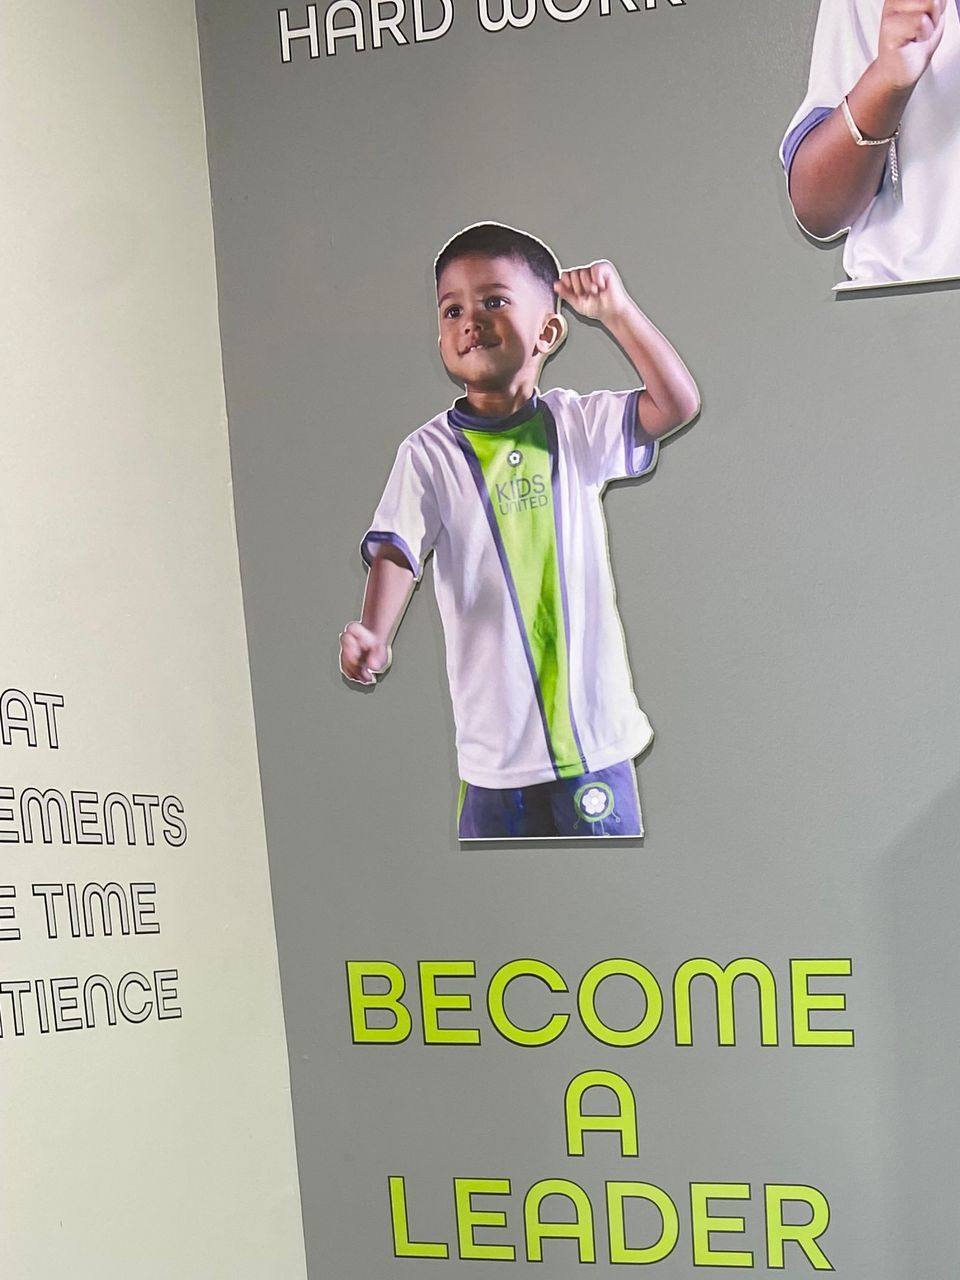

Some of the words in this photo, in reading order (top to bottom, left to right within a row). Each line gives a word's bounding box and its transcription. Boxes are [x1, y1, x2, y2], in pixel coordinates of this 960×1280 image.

[278, 0, 455, 63] HARD
[496, 474, 546, 503] KIDS
[499, 495, 549, 516] UNITED
[0, 688, 65, 749] AT
[32, 882, 160, 939] TIME
[0, 969, 182, 1038] TIENCE
[345, 957, 855, 1047] BECOME
[564, 1069, 639, 1157] A
[388, 1175, 836, 1271] LEADER
